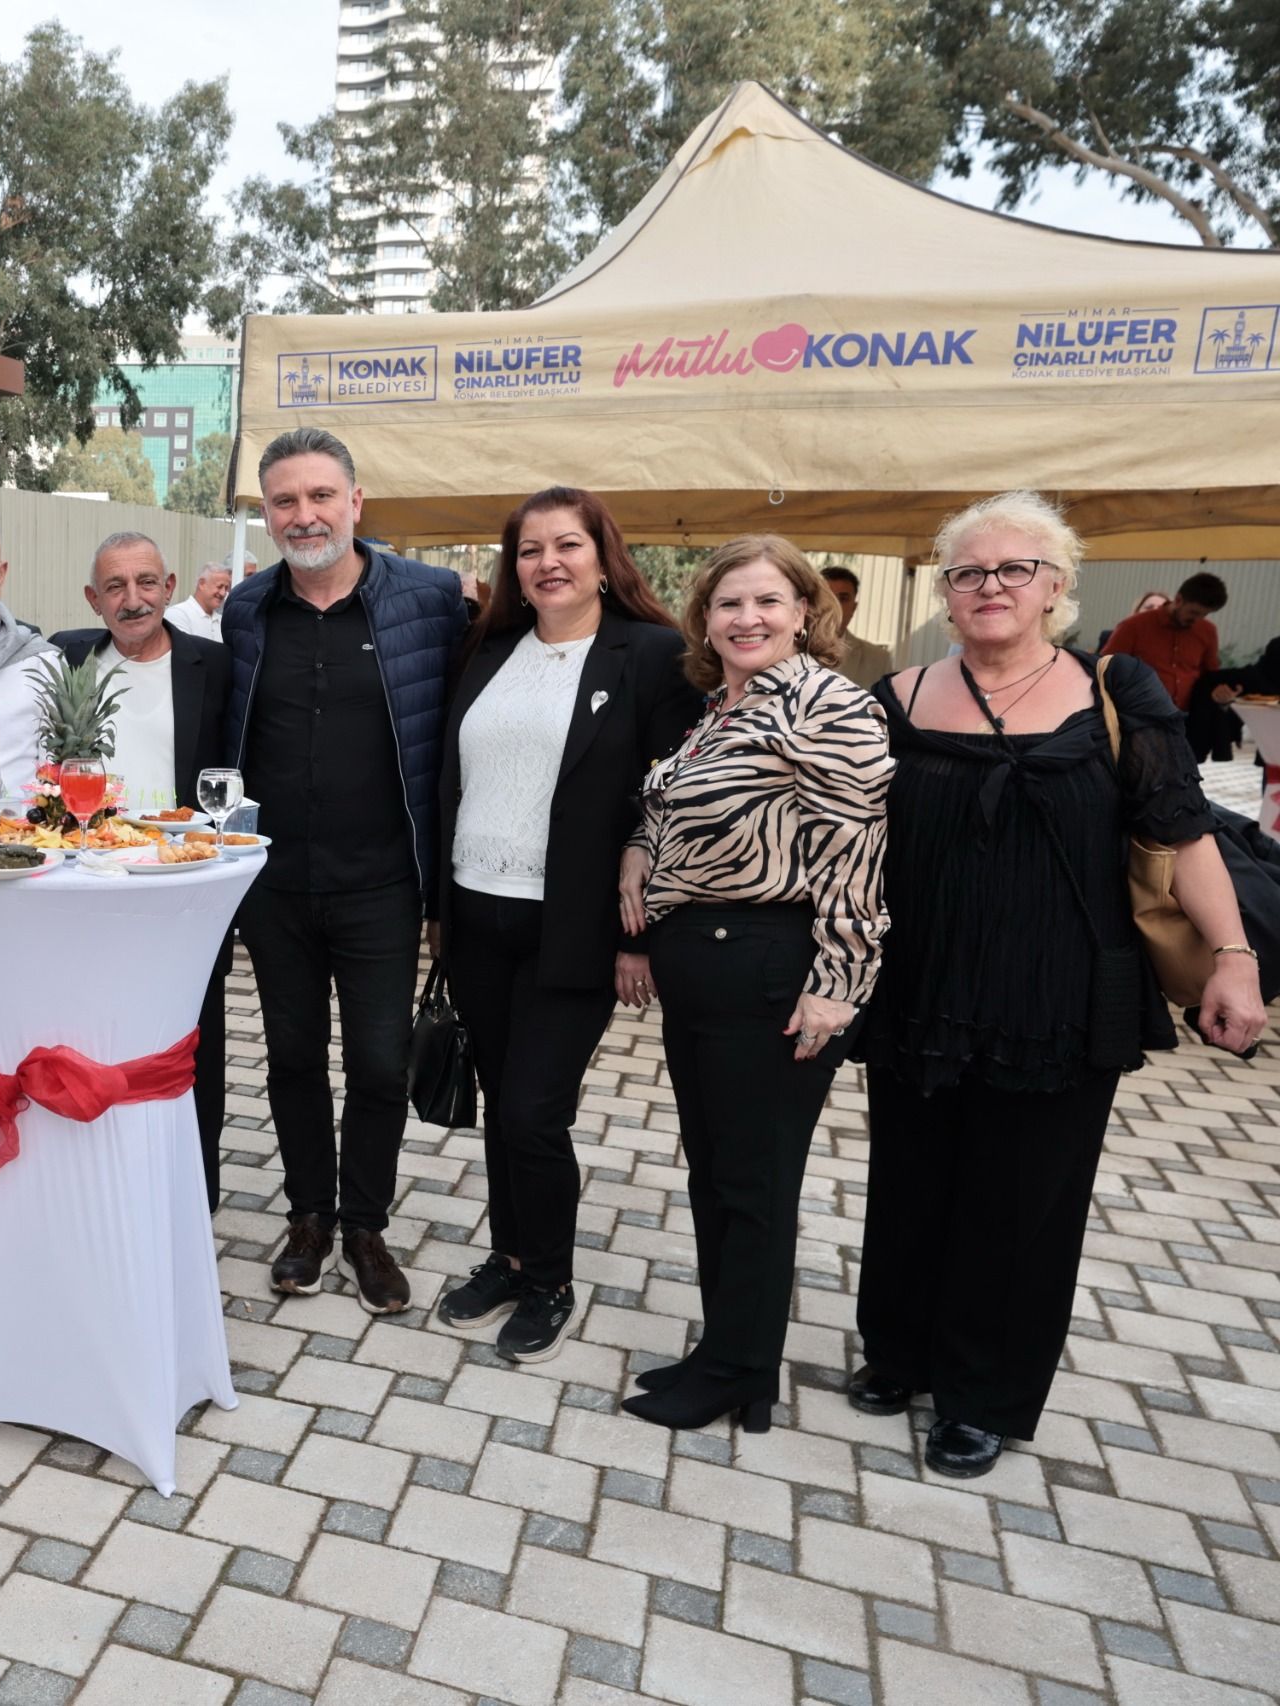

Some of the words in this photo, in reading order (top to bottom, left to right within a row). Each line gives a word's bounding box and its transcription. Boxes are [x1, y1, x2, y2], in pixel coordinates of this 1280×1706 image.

[1067, 307, 1131, 318] MİMAR
[494, 335, 544, 345] MİMAR
[338, 356, 427, 380] KONAK
[613, 328, 755, 388] Mutlu
[802, 329, 978, 369] KONAK
[1013, 350, 1096, 371] ÇINARLI
[1100, 347, 1173, 364] MUTLU
[454, 375, 520, 392] ÇINARLI
[523, 370, 581, 386] MUTLU
[1012, 368, 1053, 379] KONAK
[1056, 366, 1113, 378] BELEDİYE
[1116, 366, 1171, 377] BAŞKANI
[338, 376, 427, 396] BELEDİYESİ
[453, 391, 486, 400] KONAK
[490, 387, 535, 398] BELEDİYE
[537, 387, 581, 397] BAŞKANI
